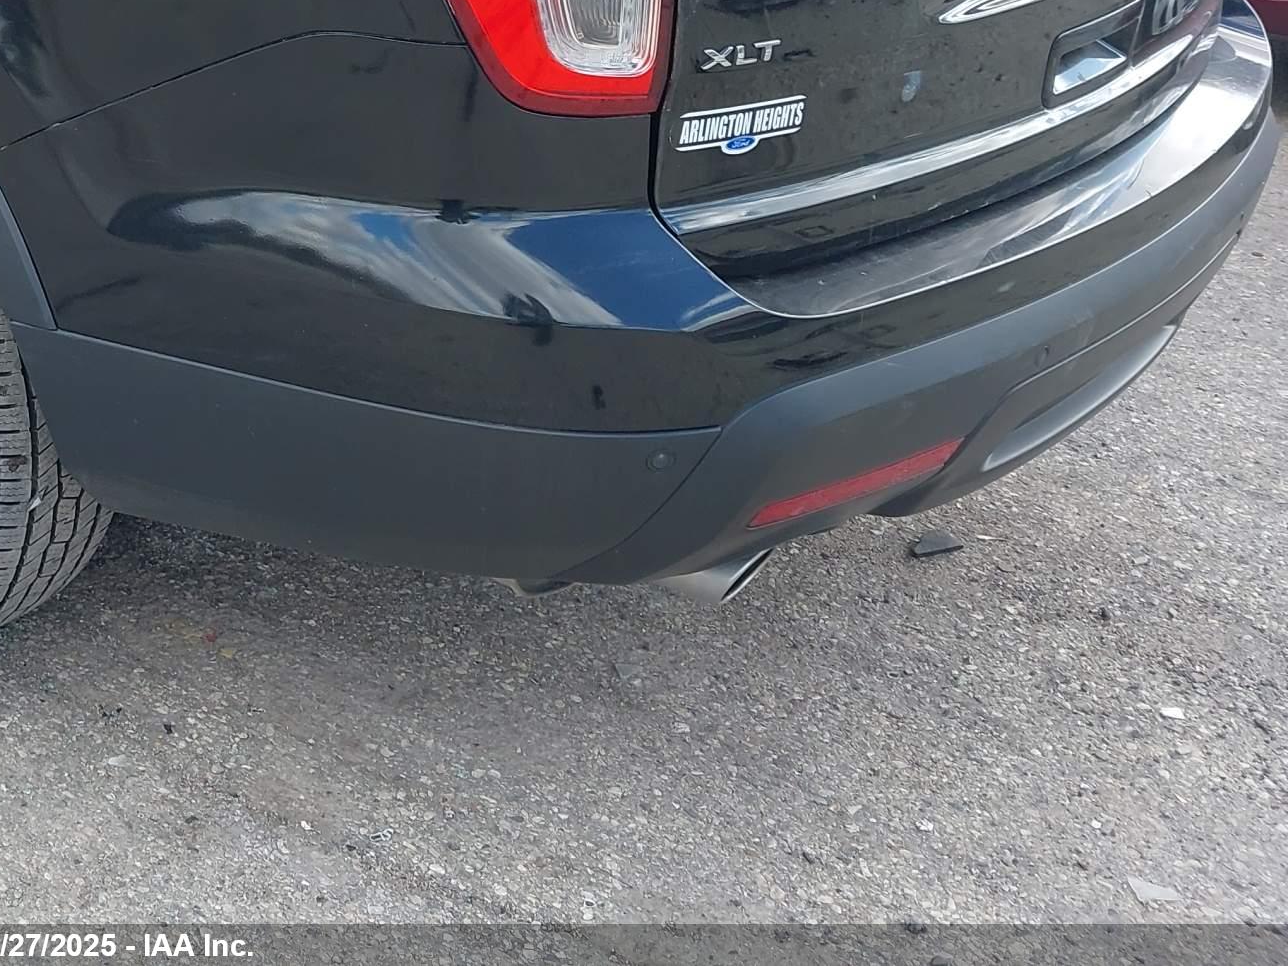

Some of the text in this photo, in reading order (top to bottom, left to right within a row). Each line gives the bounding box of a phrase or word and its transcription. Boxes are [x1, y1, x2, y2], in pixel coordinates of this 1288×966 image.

[700, 39, 781, 70] XLT
[678, 101, 805, 145] ARLINGTON HEIGHTS
